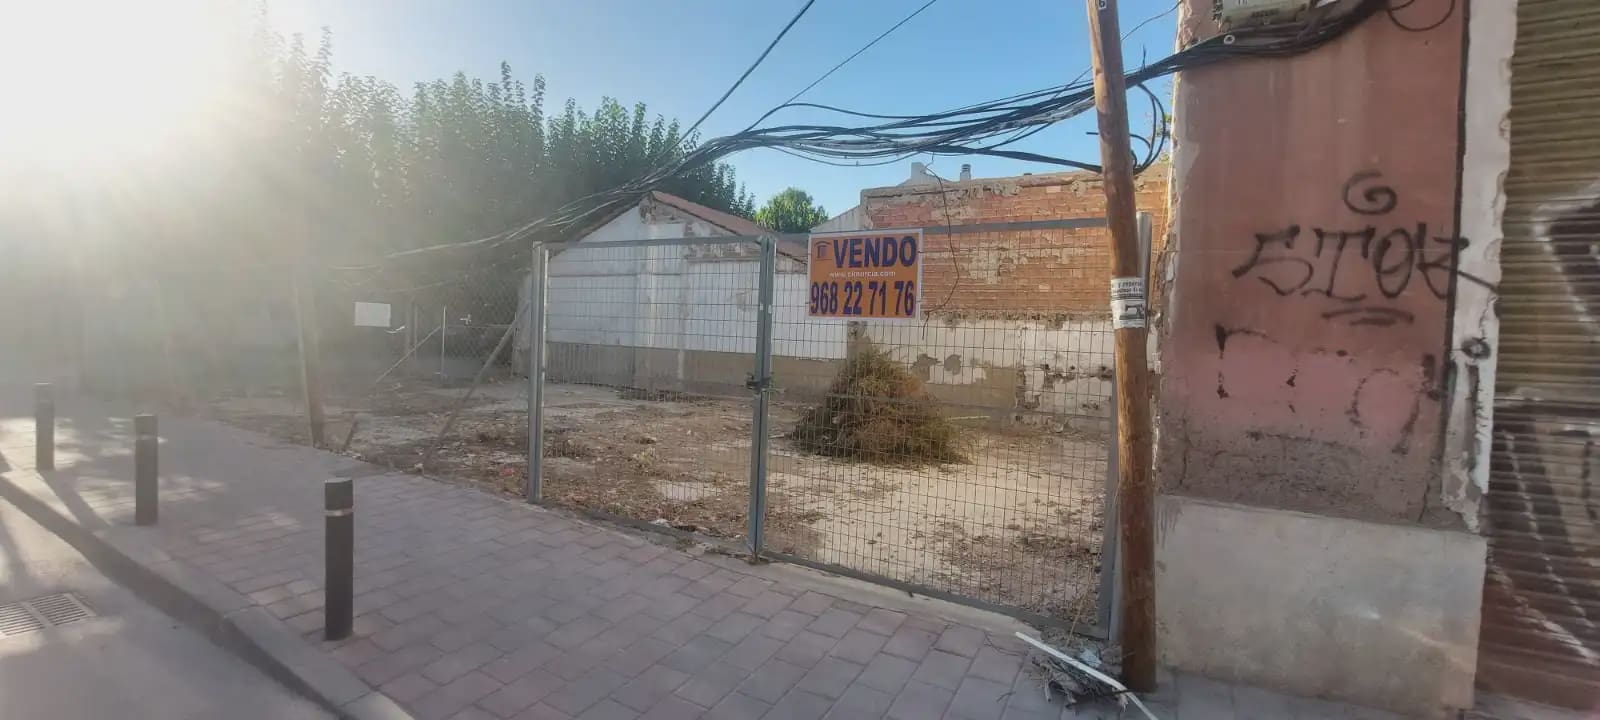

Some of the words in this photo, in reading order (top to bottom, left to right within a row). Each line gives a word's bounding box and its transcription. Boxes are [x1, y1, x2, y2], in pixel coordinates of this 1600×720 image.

[833, 236, 917, 268] VENDO
[810, 281, 838, 314] 968
[843, 281, 862, 315] 22
[868, 281, 886, 316] 71
[895, 280, 914, 316] 76
